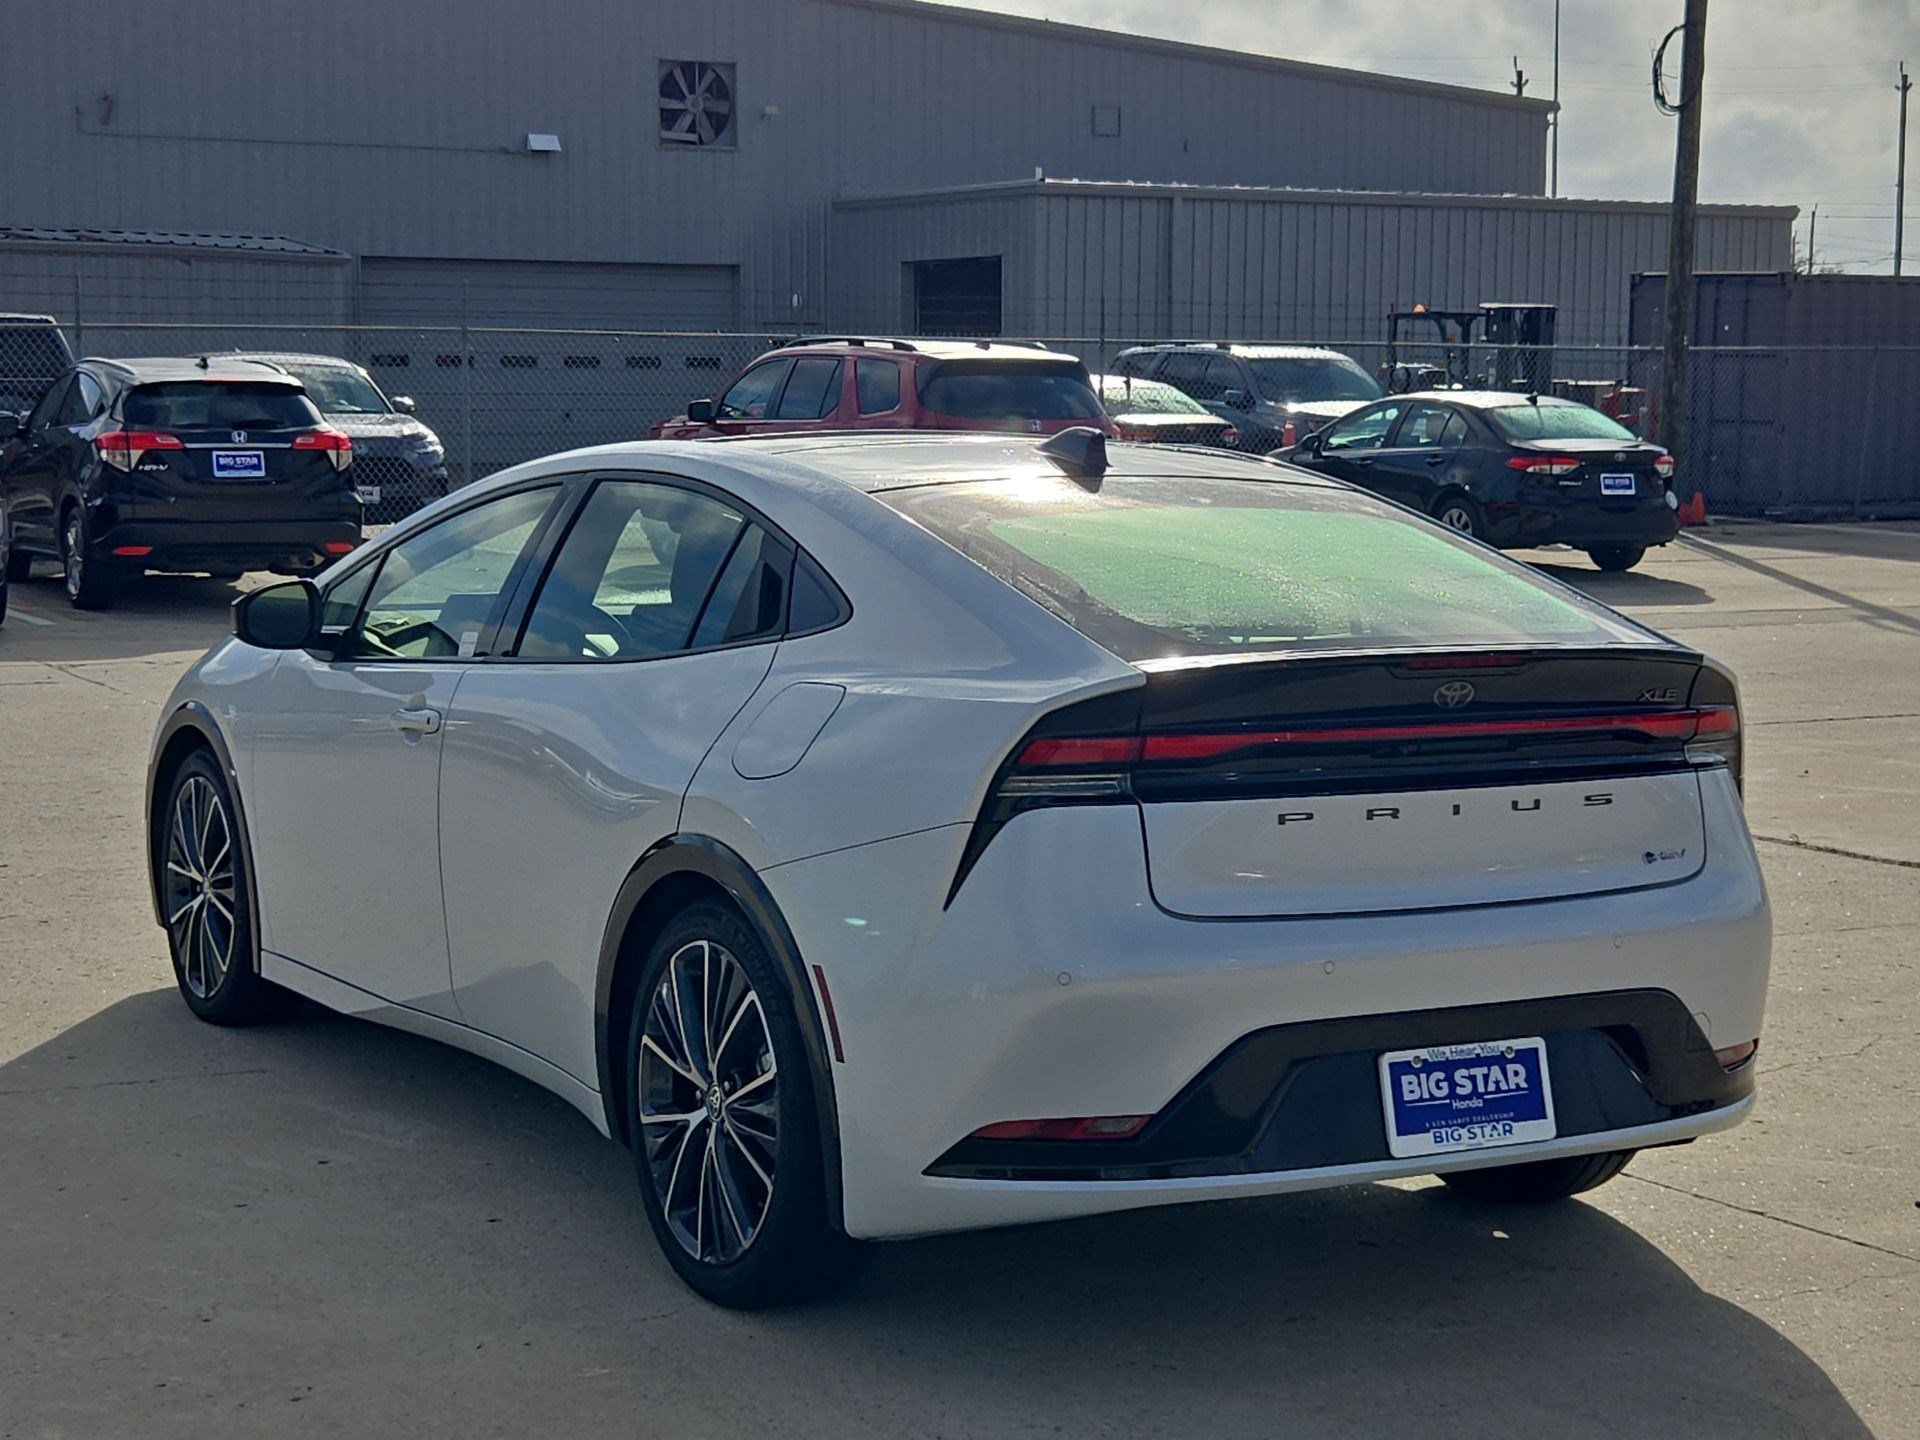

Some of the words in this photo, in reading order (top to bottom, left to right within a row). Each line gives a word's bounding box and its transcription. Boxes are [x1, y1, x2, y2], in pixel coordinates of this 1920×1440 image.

[1637, 688, 1678, 702] XLE
[1277, 793, 1613, 826] PRIUS
[1448, 1046, 1477, 1058] Hear
[1478, 1043, 1500, 1056] You
[1401, 1071, 1449, 1101] BIG
[1454, 1063, 1528, 1095] STAR
[1452, 1097, 1483, 1110] Honda
[1433, 1128, 1462, 1144] BIG
[1467, 1122, 1513, 1140] STAR
